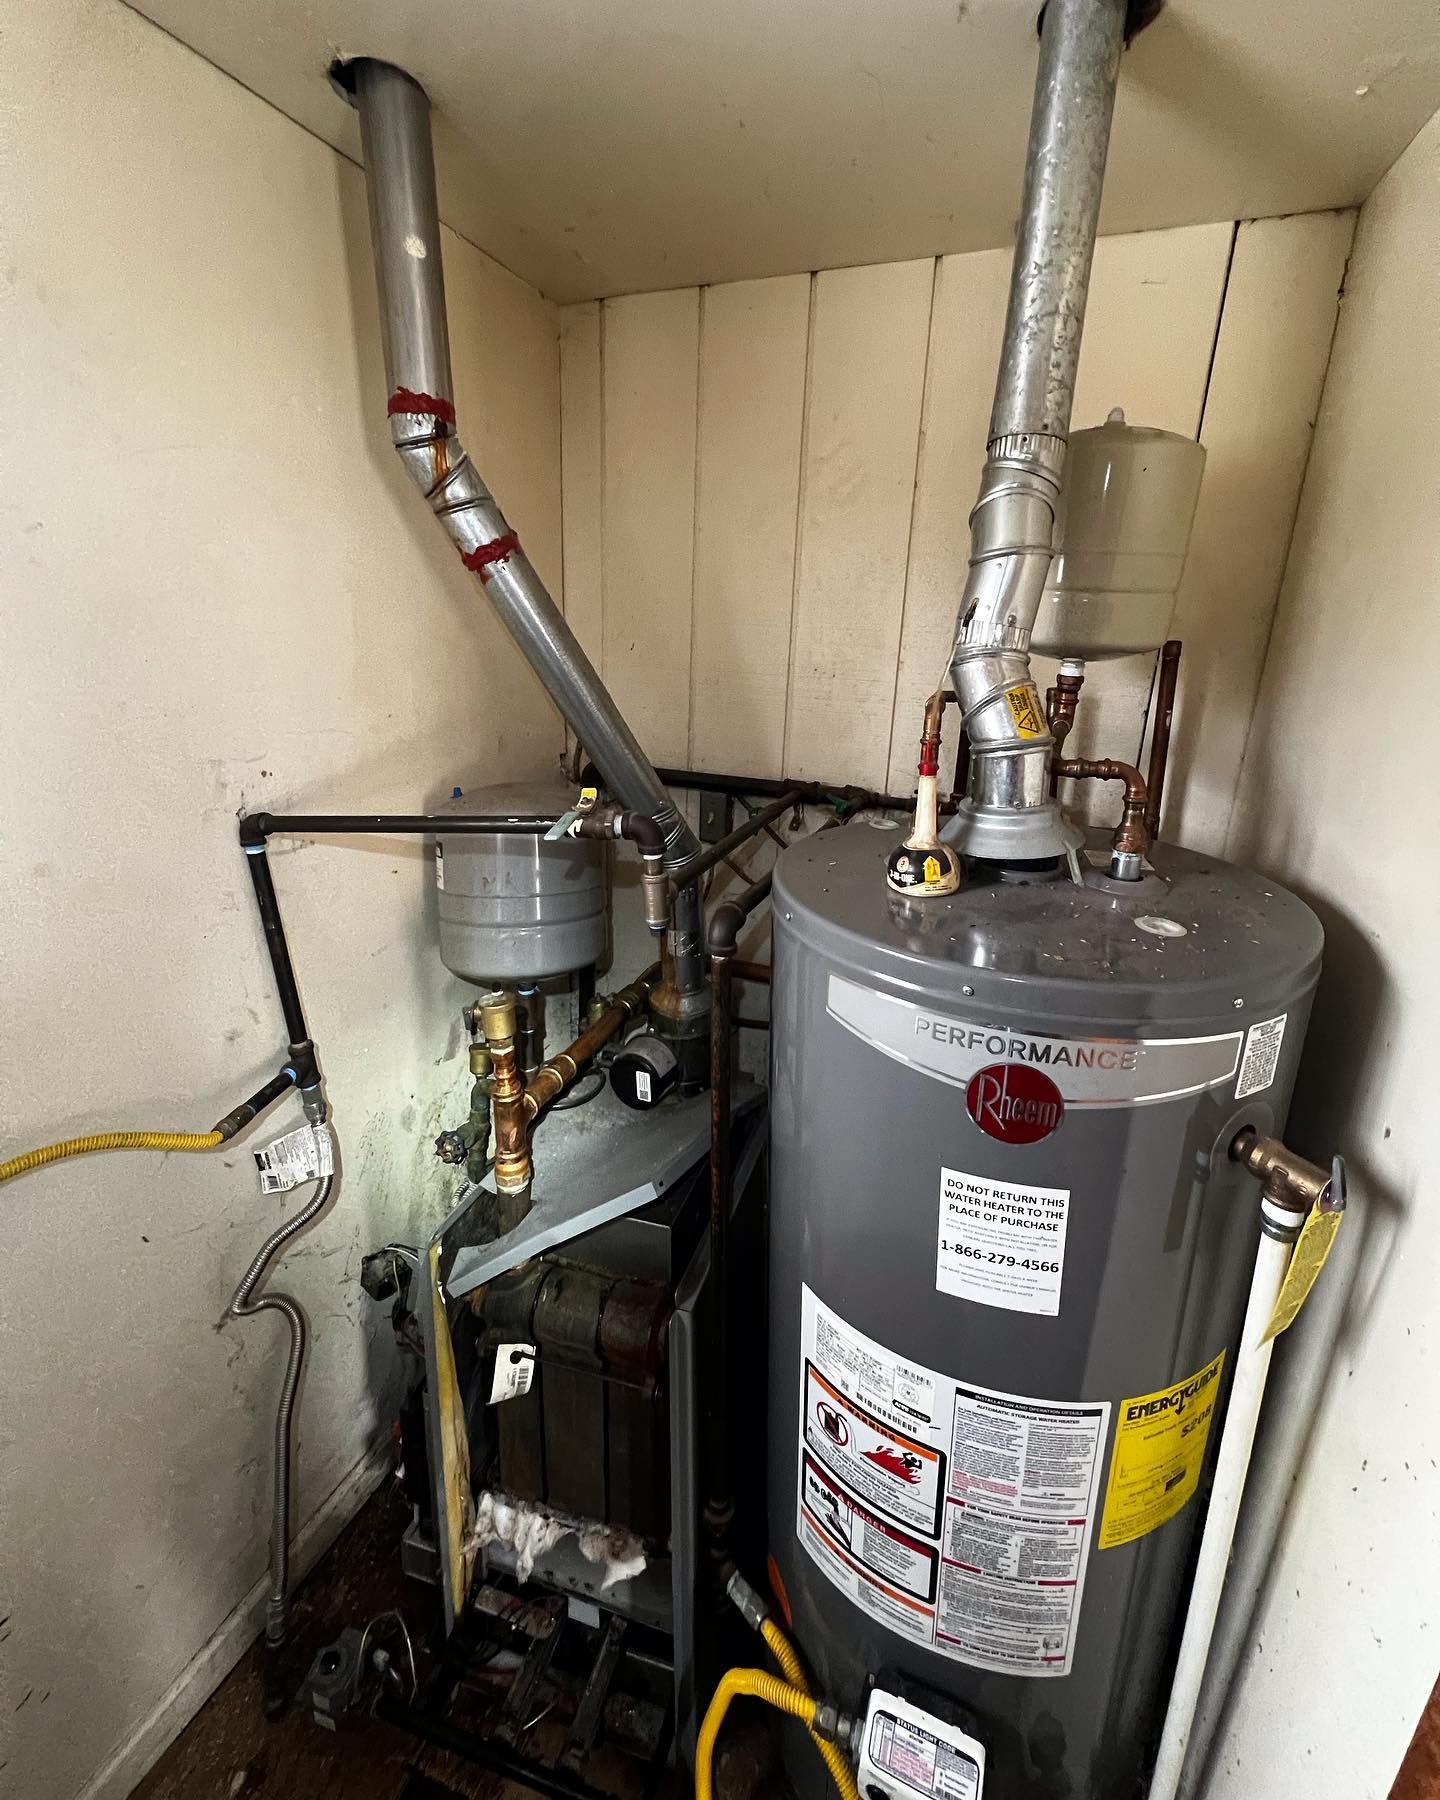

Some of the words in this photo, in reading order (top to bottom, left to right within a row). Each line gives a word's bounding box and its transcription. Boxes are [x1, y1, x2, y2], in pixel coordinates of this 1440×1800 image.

[915, 1015, 1137, 1071] PERFORMANCE
[976, 1065, 1058, 1130] Rheem
[944, 1189, 981, 1206] WATER
[983, 1200, 1025, 1215] HEATER
[1027, 1208, 1042, 1217] TO
[1044, 1210, 1064, 1220] THE
[947, 1178, 964, 1190] DO
[966, 1184, 990, 1196] NOT
[992, 1190, 1037, 1204] RETURN
[1040, 1197, 1065, 1208] THIS
[949, 1203, 980, 1219] PLACE
[983, 1213, 998, 1222] OF
[1001, 1216, 1059, 1232] PURCHASE
[941, 1239, 1059, 1273] 1-866-279-4566
[975, 1394, 1014, 1408] INSTALLATION
[1015, 1403, 1028, 1411] AND
[1028, 1406, 1061, 1415] OPERATION
[976, 1404, 1010, 1416] AUTOMATIC
[1011, 1412, 1038, 1421] STORAGE
[847, 1402, 896, 1442] WARNING
[847, 1501, 887, 1533] DANGER
[896, 1717, 920, 1736] STATUS
[919, 1729, 937, 1744] LIGHT
[938, 1740, 957, 1754] CODE
